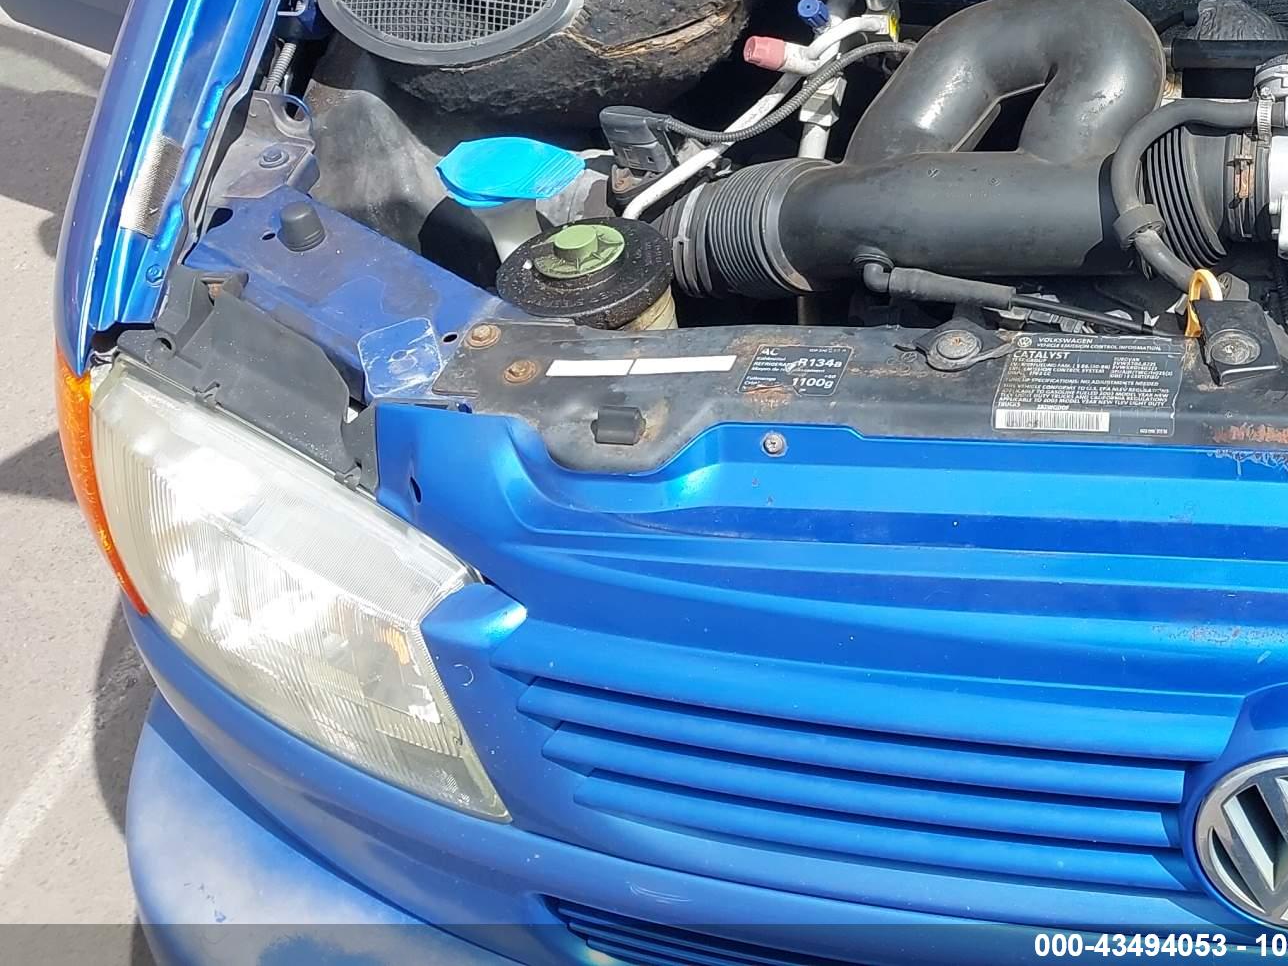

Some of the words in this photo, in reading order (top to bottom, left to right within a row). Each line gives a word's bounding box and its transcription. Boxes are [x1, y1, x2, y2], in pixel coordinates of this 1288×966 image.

[761, 348, 780, 356] AC
[1014, 350, 1071, 360] CATALYST
[799, 358, 843, 368] R134a
[792, 378, 834, 389] 1100g
